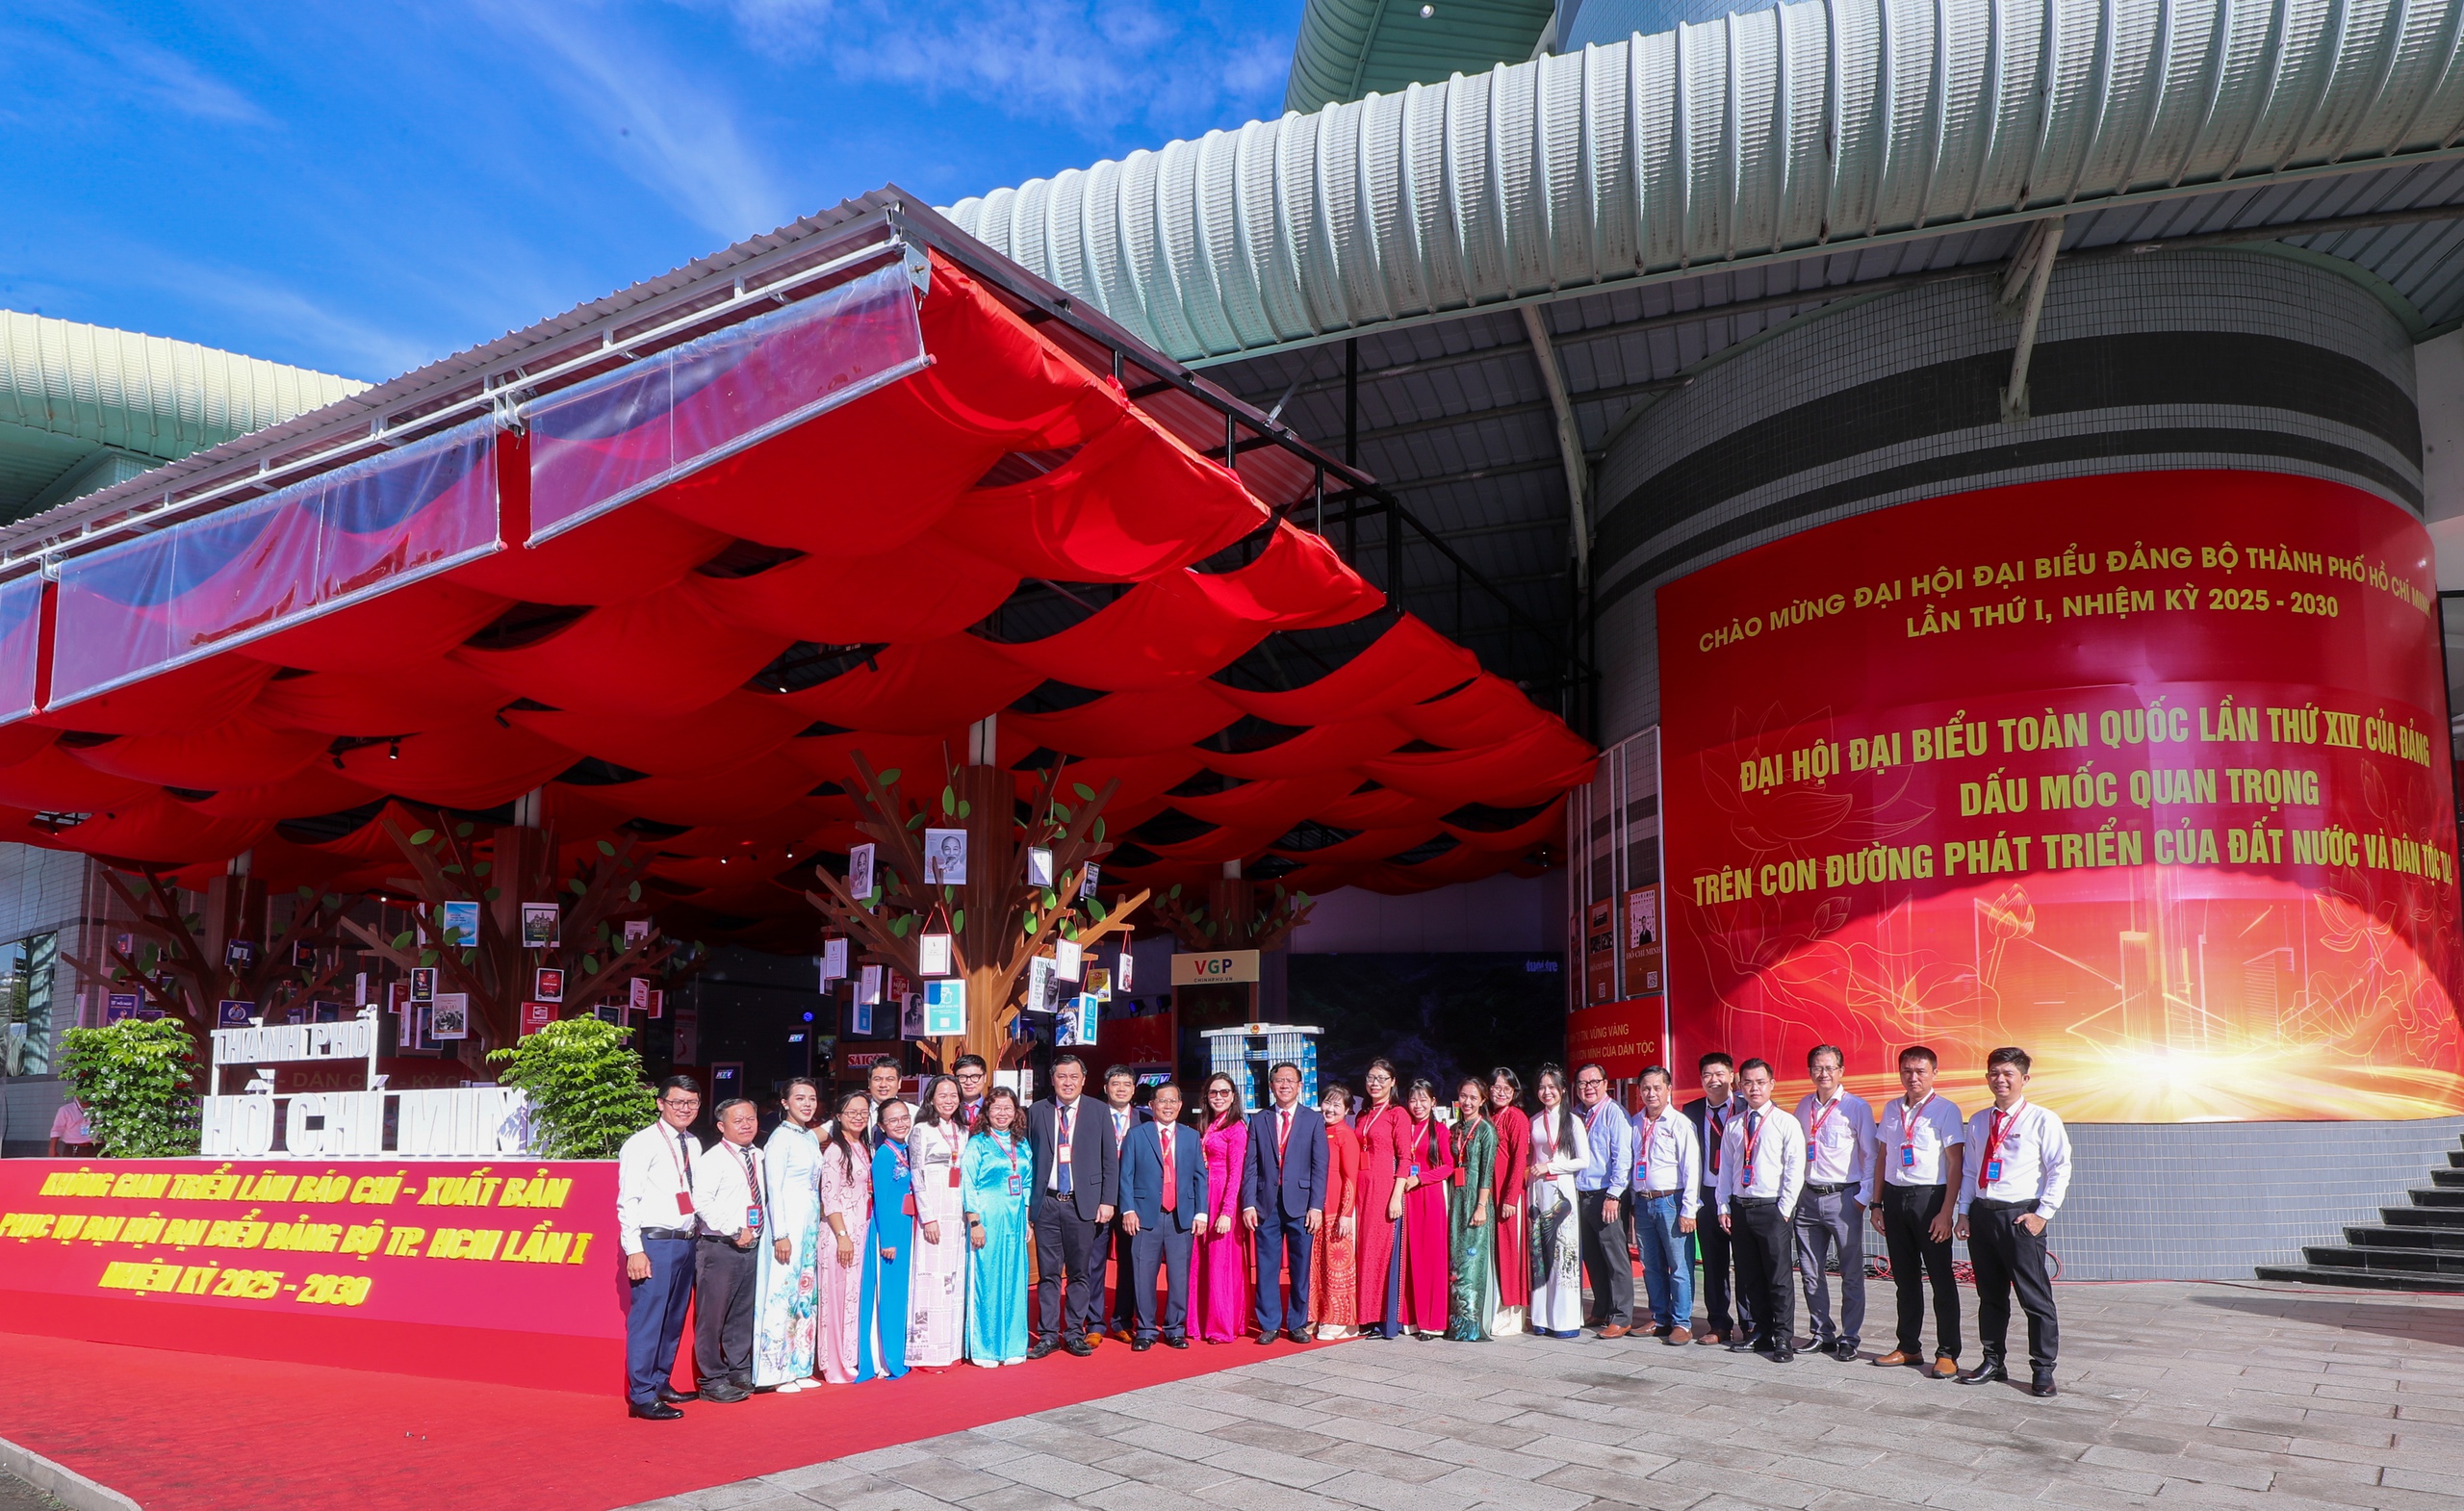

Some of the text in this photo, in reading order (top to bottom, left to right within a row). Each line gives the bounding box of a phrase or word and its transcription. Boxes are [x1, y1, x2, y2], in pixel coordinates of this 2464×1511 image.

[1699, 541, 2431, 653] CHÀO MỪNG ĐẠI HỘI ĐẠI BIỂU ĐẢNG BỘ THÀNH PHỐ HỒ CHÍ MINH
[1906, 603, 1961, 638] LẦN
[1969, 595, 2027, 627] THỨ
[2035, 600, 2052, 624] I,
[2063, 586, 2155, 620] NHIỆM
[2165, 582, 2199, 611] KỲ
[2209, 588, 2270, 611] 2025
[2291, 591, 2339, 618] 2030
[1740, 694, 2430, 795] ĐẠI HỘI ĐẠI BIỂU TOÀN QUỐC LẦN THỨ XIV CỦA ĐẢNG
[1960, 760, 2320, 817] DẤU MỐC QUAN TRỌNG
[1693, 816, 2453, 908] TRÊN CON ĐƯỜNG PHÁT TRIỂN CỦA ĐẤT NƯỚC VÀ DÂN TỘC TA!
[1194, 959, 1232, 975] VGP
[210, 1004, 378, 1064] THÀNH PHỐ
[1602, 1043, 1617, 1058] CỦA
[1618, 1041, 1634, 1057] DÂN
[1636, 1039, 1655, 1057] TỘC
[1608, 1022, 1630, 1037] VÀNG
[1138, 1074, 1169, 1086] HTV
[201, 1068, 276, 1156] HỒ
[284, 1074, 390, 1156] CHÍ
[38, 1166, 116, 1197] KHÔNG
[110, 1173, 172, 1199] GIAN
[167, 1162, 241, 1201] TRIỂN
[235, 1169, 298, 1203] LÃM
[292, 1168, 351, 1203] BÁO
[349, 1169, 407, 1205] CHÍ
[417, 1166, 502, 1207] XUẤT
[498, 1167, 573, 1208] BẢN
[0, 1208, 593, 1266] PHỤC VỤ ĐẠI HỘI ĐẠI BIỂU ĐẢNG BỘ TP. HCM LẦN I
[97, 1257, 183, 1296] NHIỆM
[175, 1260, 220, 1295] KỲ
[212, 1268, 285, 1300] 2025
[295, 1273, 372, 1307] 2030
